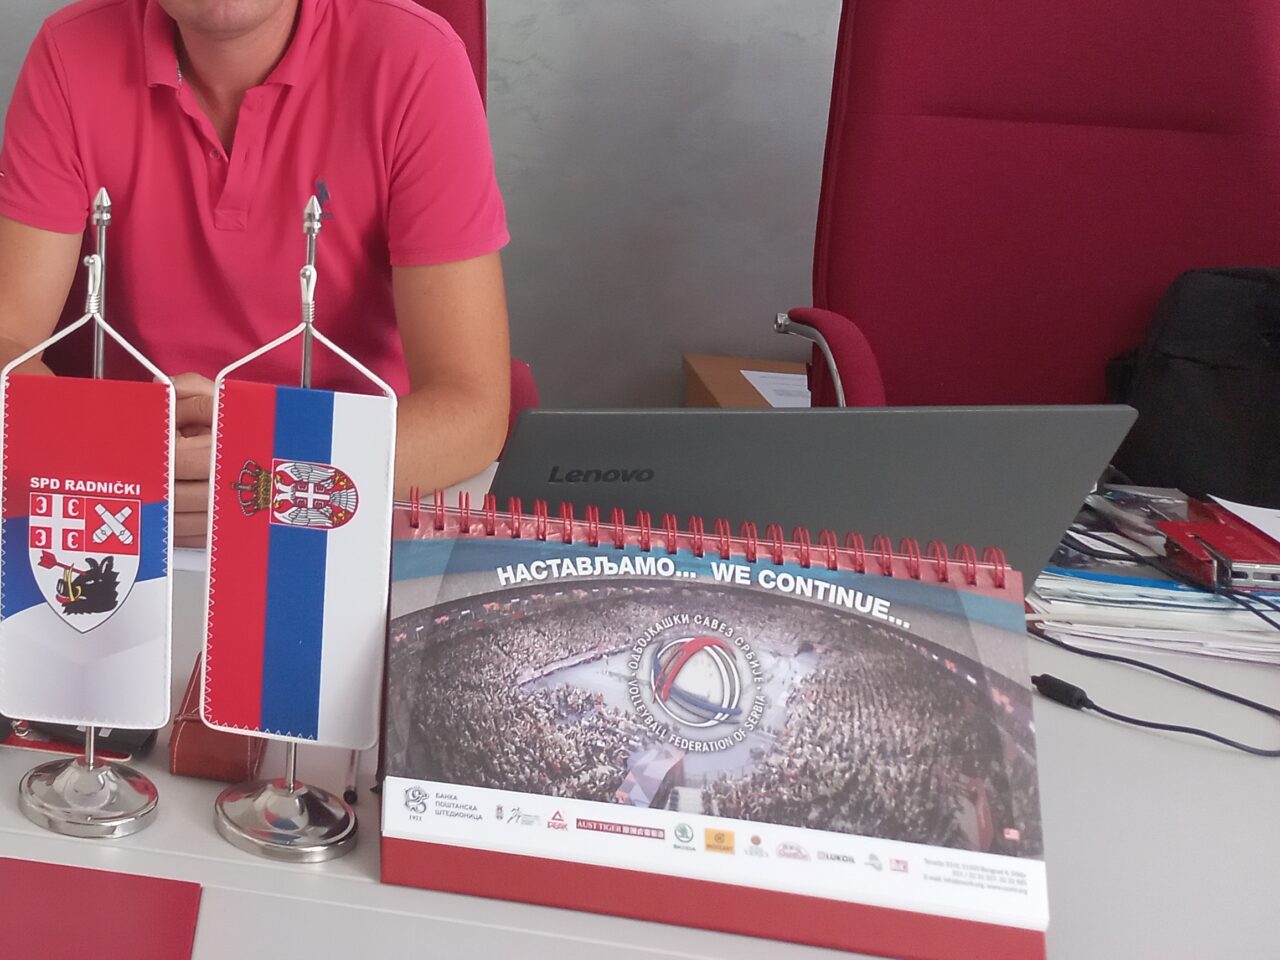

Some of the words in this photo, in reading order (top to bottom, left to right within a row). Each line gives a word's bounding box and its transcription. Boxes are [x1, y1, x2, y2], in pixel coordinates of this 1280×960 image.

[30, 476, 60, 490] SPD
[64, 480, 141, 495] RADNIČKI
[547, 465, 655, 483] Lenovo
[496, 556, 697, 586] НАСТАВЉАМО...
[710, 561, 752, 586] WE
[758, 569, 911, 629] CONTINUE...
[628, 613, 690, 670] ОДБОЈКАШКИ
[694, 614, 734, 638] САВЕЗ
[734, 636, 765, 683] СРБИЈЕ
[628, 680, 668, 739] VOLLEYBALL
[668, 733, 734, 752] FEDERATION
[733, 728, 747, 742] OF
[743, 694, 766, 732] SERBIA
